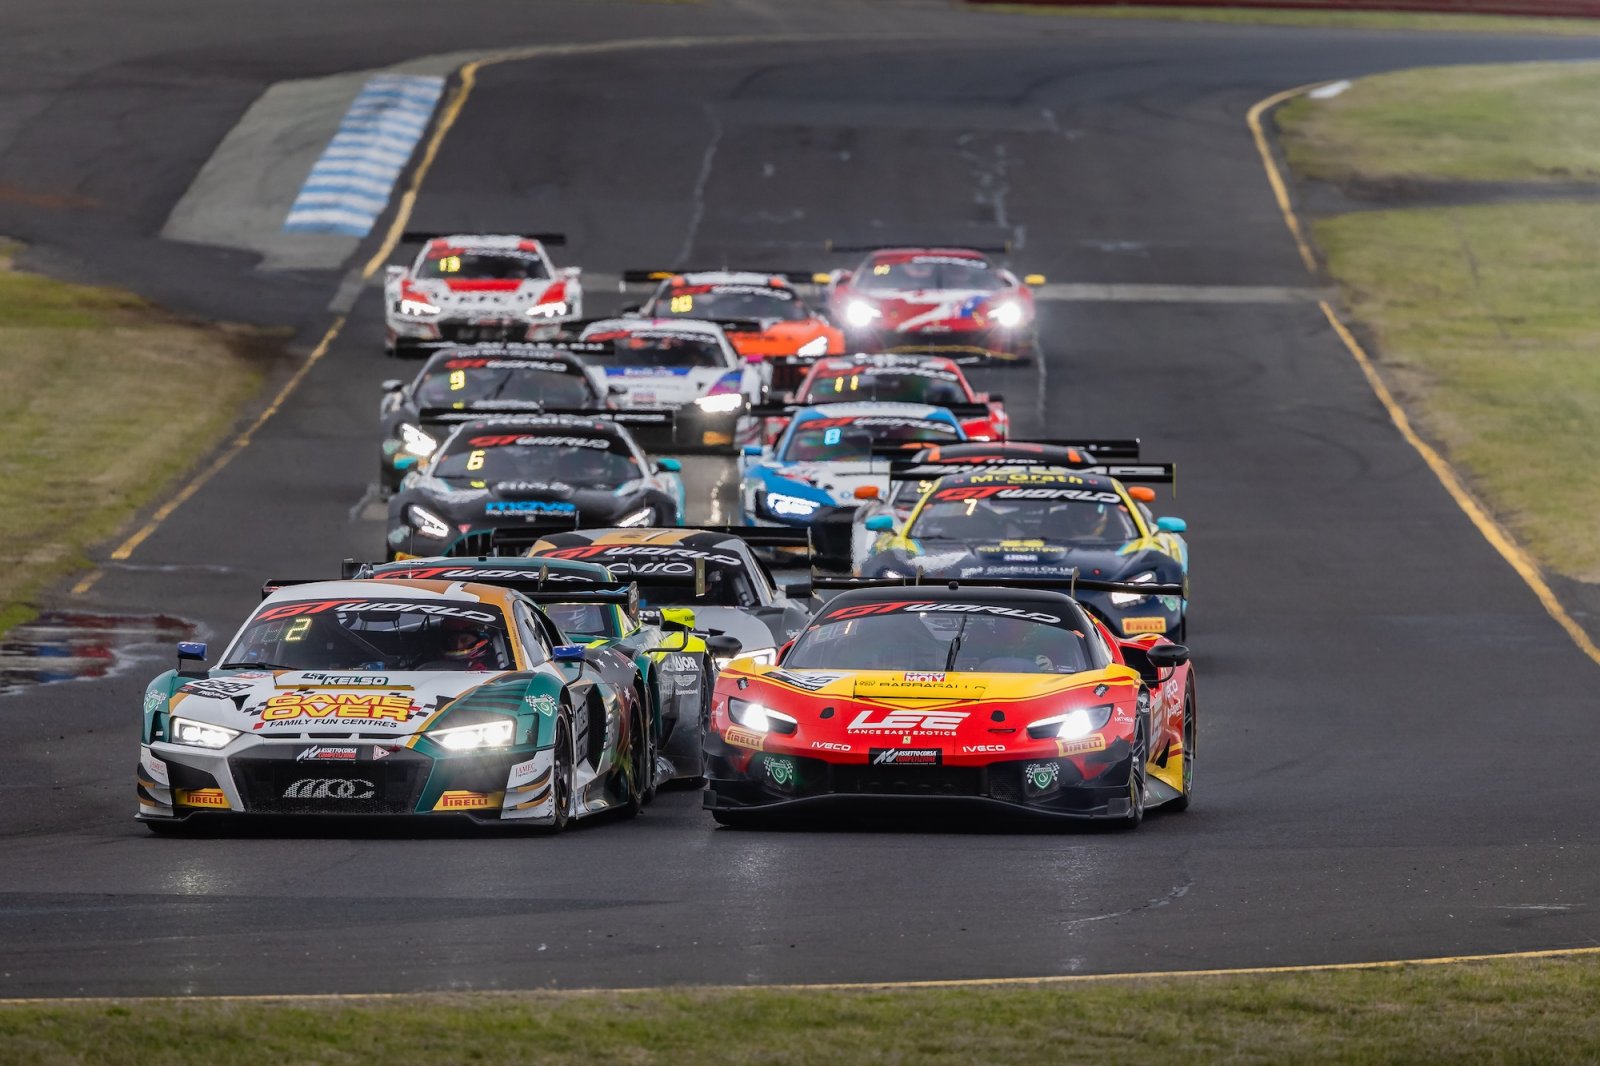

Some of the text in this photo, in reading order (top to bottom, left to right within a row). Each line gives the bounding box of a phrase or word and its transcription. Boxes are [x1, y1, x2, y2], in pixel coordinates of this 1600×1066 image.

[450, 370, 465, 391] 9
[467, 450, 485, 471] 6
[963, 498, 978, 516] 7
[285, 617, 313, 642] 2
[322, 676, 389, 686] KELSO
[266, 694, 415, 708] GAME
[262, 705, 410, 722] OVER
[847, 710, 971, 730] LEE
[269, 719, 312, 727] FAMILY
[345, 719, 398, 728] CENTRES
[726, 729, 762, 747] PIRELLI
[811, 741, 852, 751] IVECO
[962, 744, 1006, 753] IVECO
[187, 792, 224, 804] PIRELLI
[442, 794, 488, 807] PIRELLI
